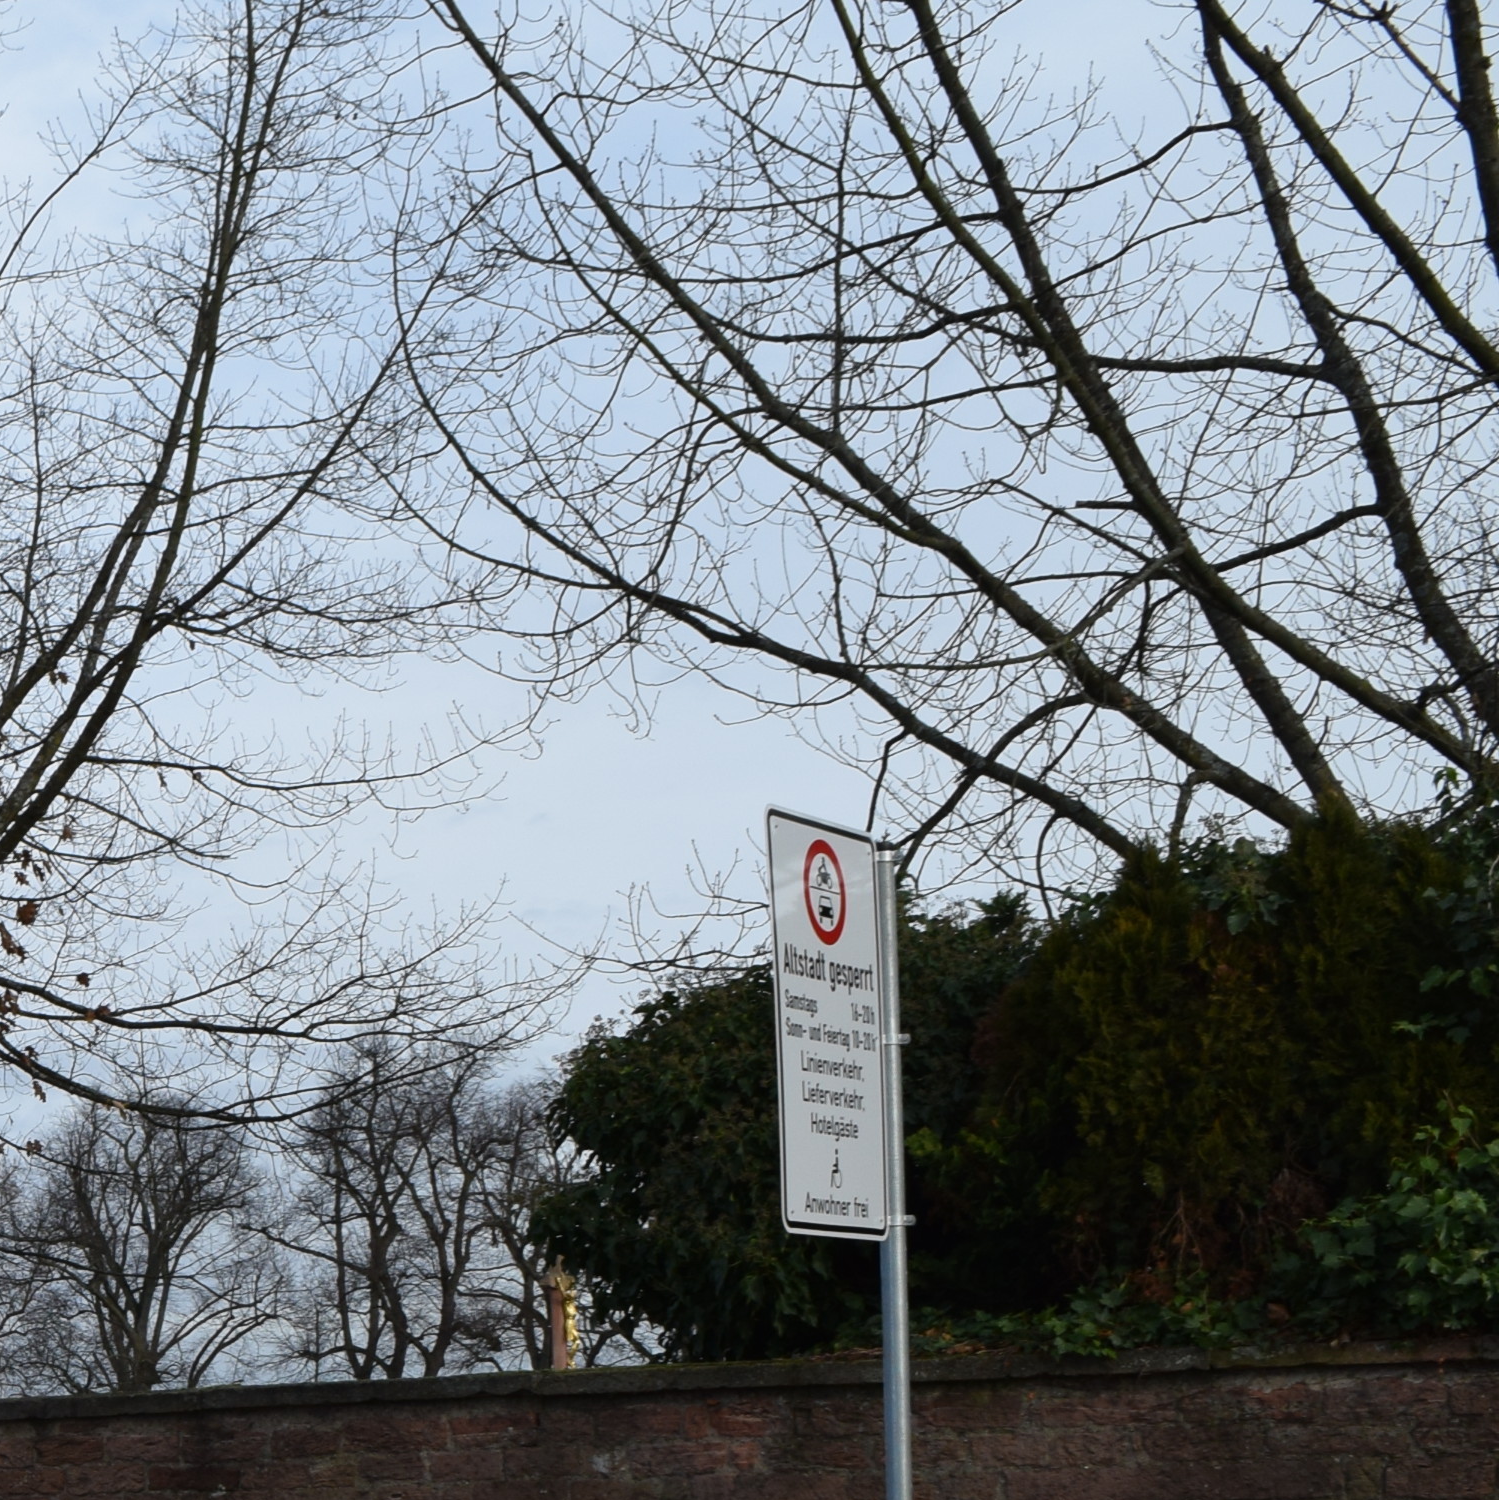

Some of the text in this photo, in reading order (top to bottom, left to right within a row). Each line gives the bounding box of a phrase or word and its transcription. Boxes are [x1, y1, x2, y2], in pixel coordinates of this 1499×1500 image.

[783, 942, 874, 996] Altstadt gesperrt
[784, 988, 818, 1018] Samstags
[785, 1016, 807, 1039] Sonn-
[808, 1023, 822, 1042] und
[822, 1023, 850, 1052] Feiertag
[800, 1050, 865, 1082] Linienverkehr,
[801, 1080, 865, 1112] Lieferverkehr,
[810, 1112, 859, 1142] Hotelgäste
[804, 1191, 869, 1219] Anwohner frei
